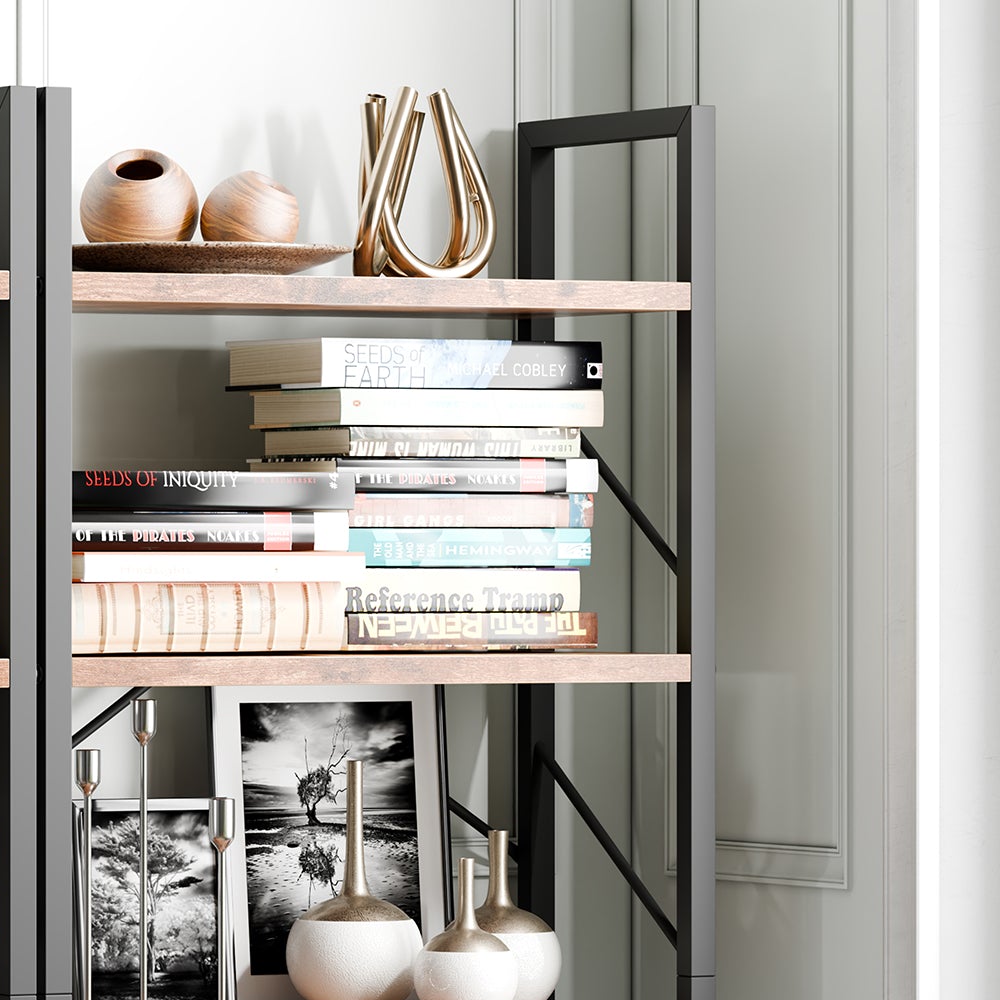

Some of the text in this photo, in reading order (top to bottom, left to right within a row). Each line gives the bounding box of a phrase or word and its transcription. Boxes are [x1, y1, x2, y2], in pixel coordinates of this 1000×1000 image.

[344, 343, 425, 365] SEEDS of
[344, 365, 426, 388] EARTH
[447, 363, 567, 377] MICHAEL COBLEY
[394, 441, 411, 457] IS
[418, 441, 475, 457] WOMAN
[485, 441, 520, 457] THIS
[530, 444, 573, 454] LIBRARY
[85, 470, 239, 492] SEEDS OF INIQUITY
[369, 473, 393, 485] THE
[399, 473, 457, 485] PIRATES
[467, 473, 517, 486] NOAKES
[353, 514, 465, 527] GIRL GANGS
[75, 529, 94, 542] OF
[100, 529, 127, 542] THE
[132, 528, 196, 543] PIRATES
[207, 529, 260, 543] NOAKES
[373, 542, 383, 558] THE
[384, 542, 394, 558] OLD
[445, 545, 554, 556] HEMINGWAY
[345, 587, 565, 612] Reference Tramp
[357, 613, 483, 639] BETWEEN
[545, 612, 587, 636] THE
